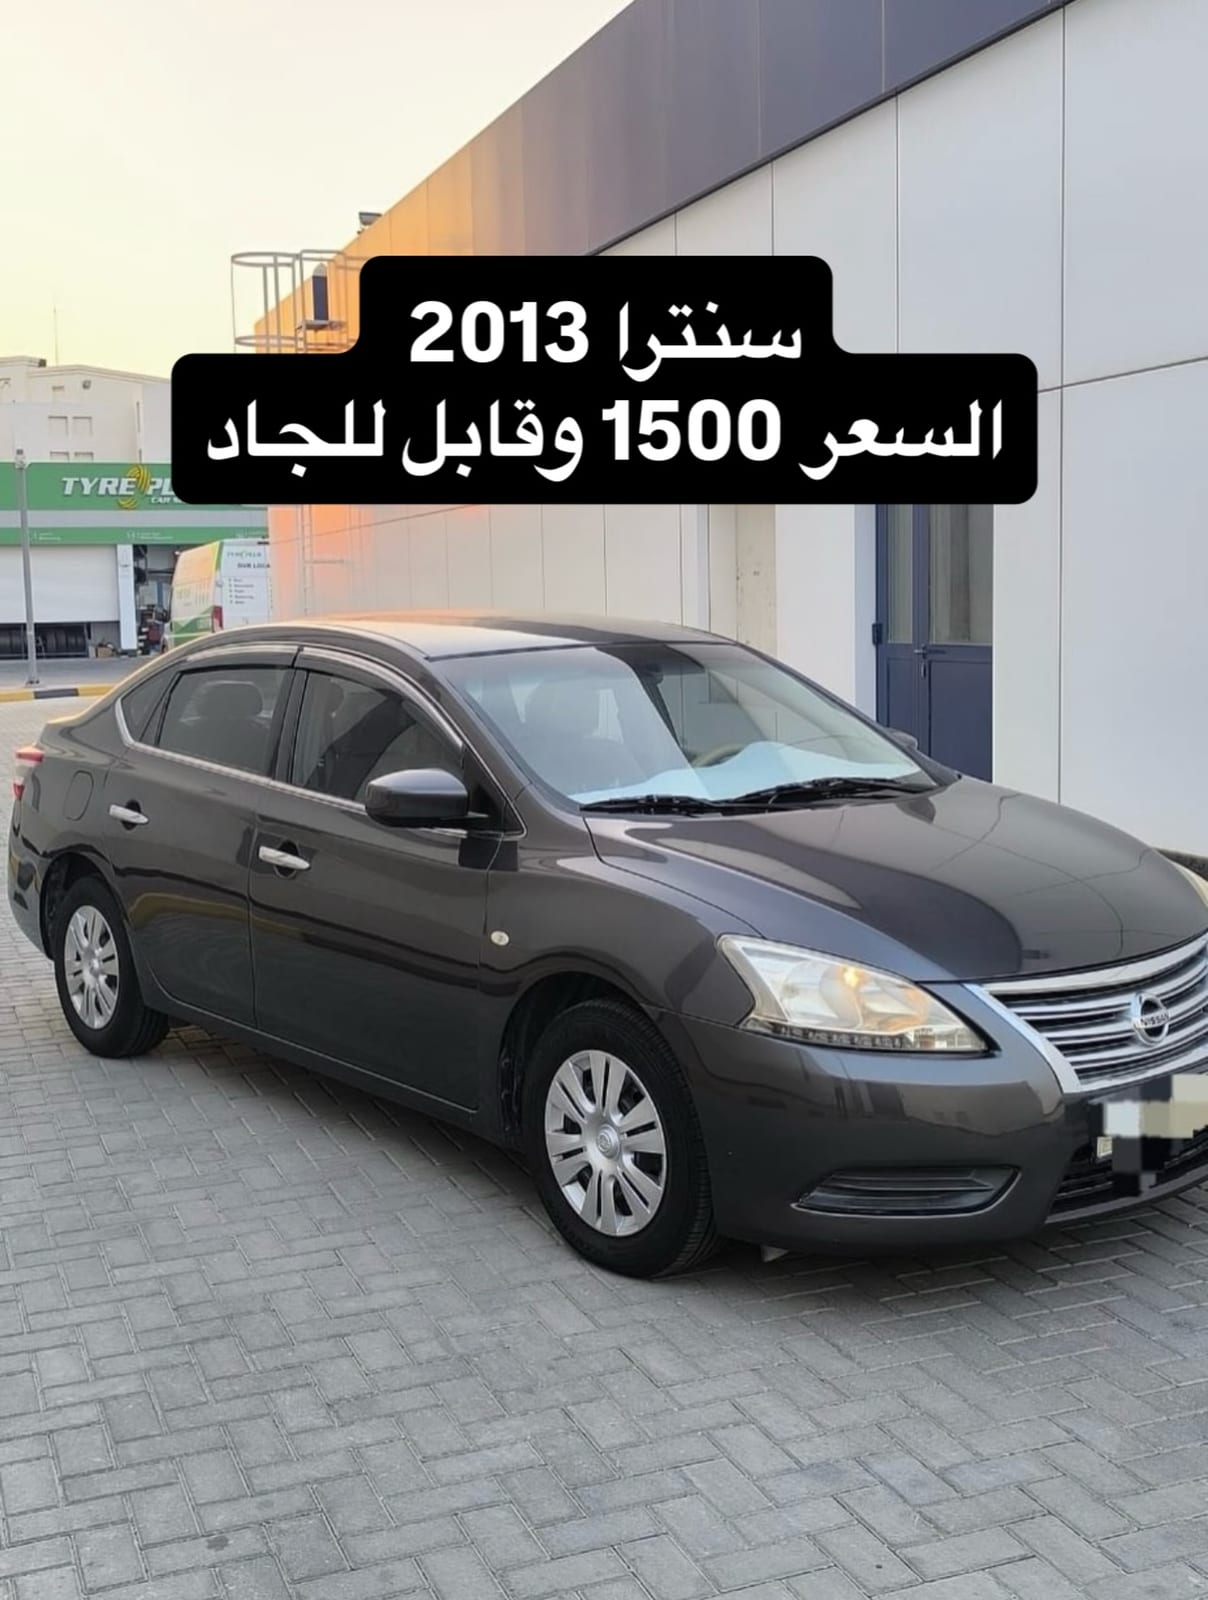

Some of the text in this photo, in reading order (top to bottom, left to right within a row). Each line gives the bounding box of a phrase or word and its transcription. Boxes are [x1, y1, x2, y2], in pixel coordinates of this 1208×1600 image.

[62, 477, 175, 495] TYRE PL
[1139, 1013, 1169, 1026] NISSAN
